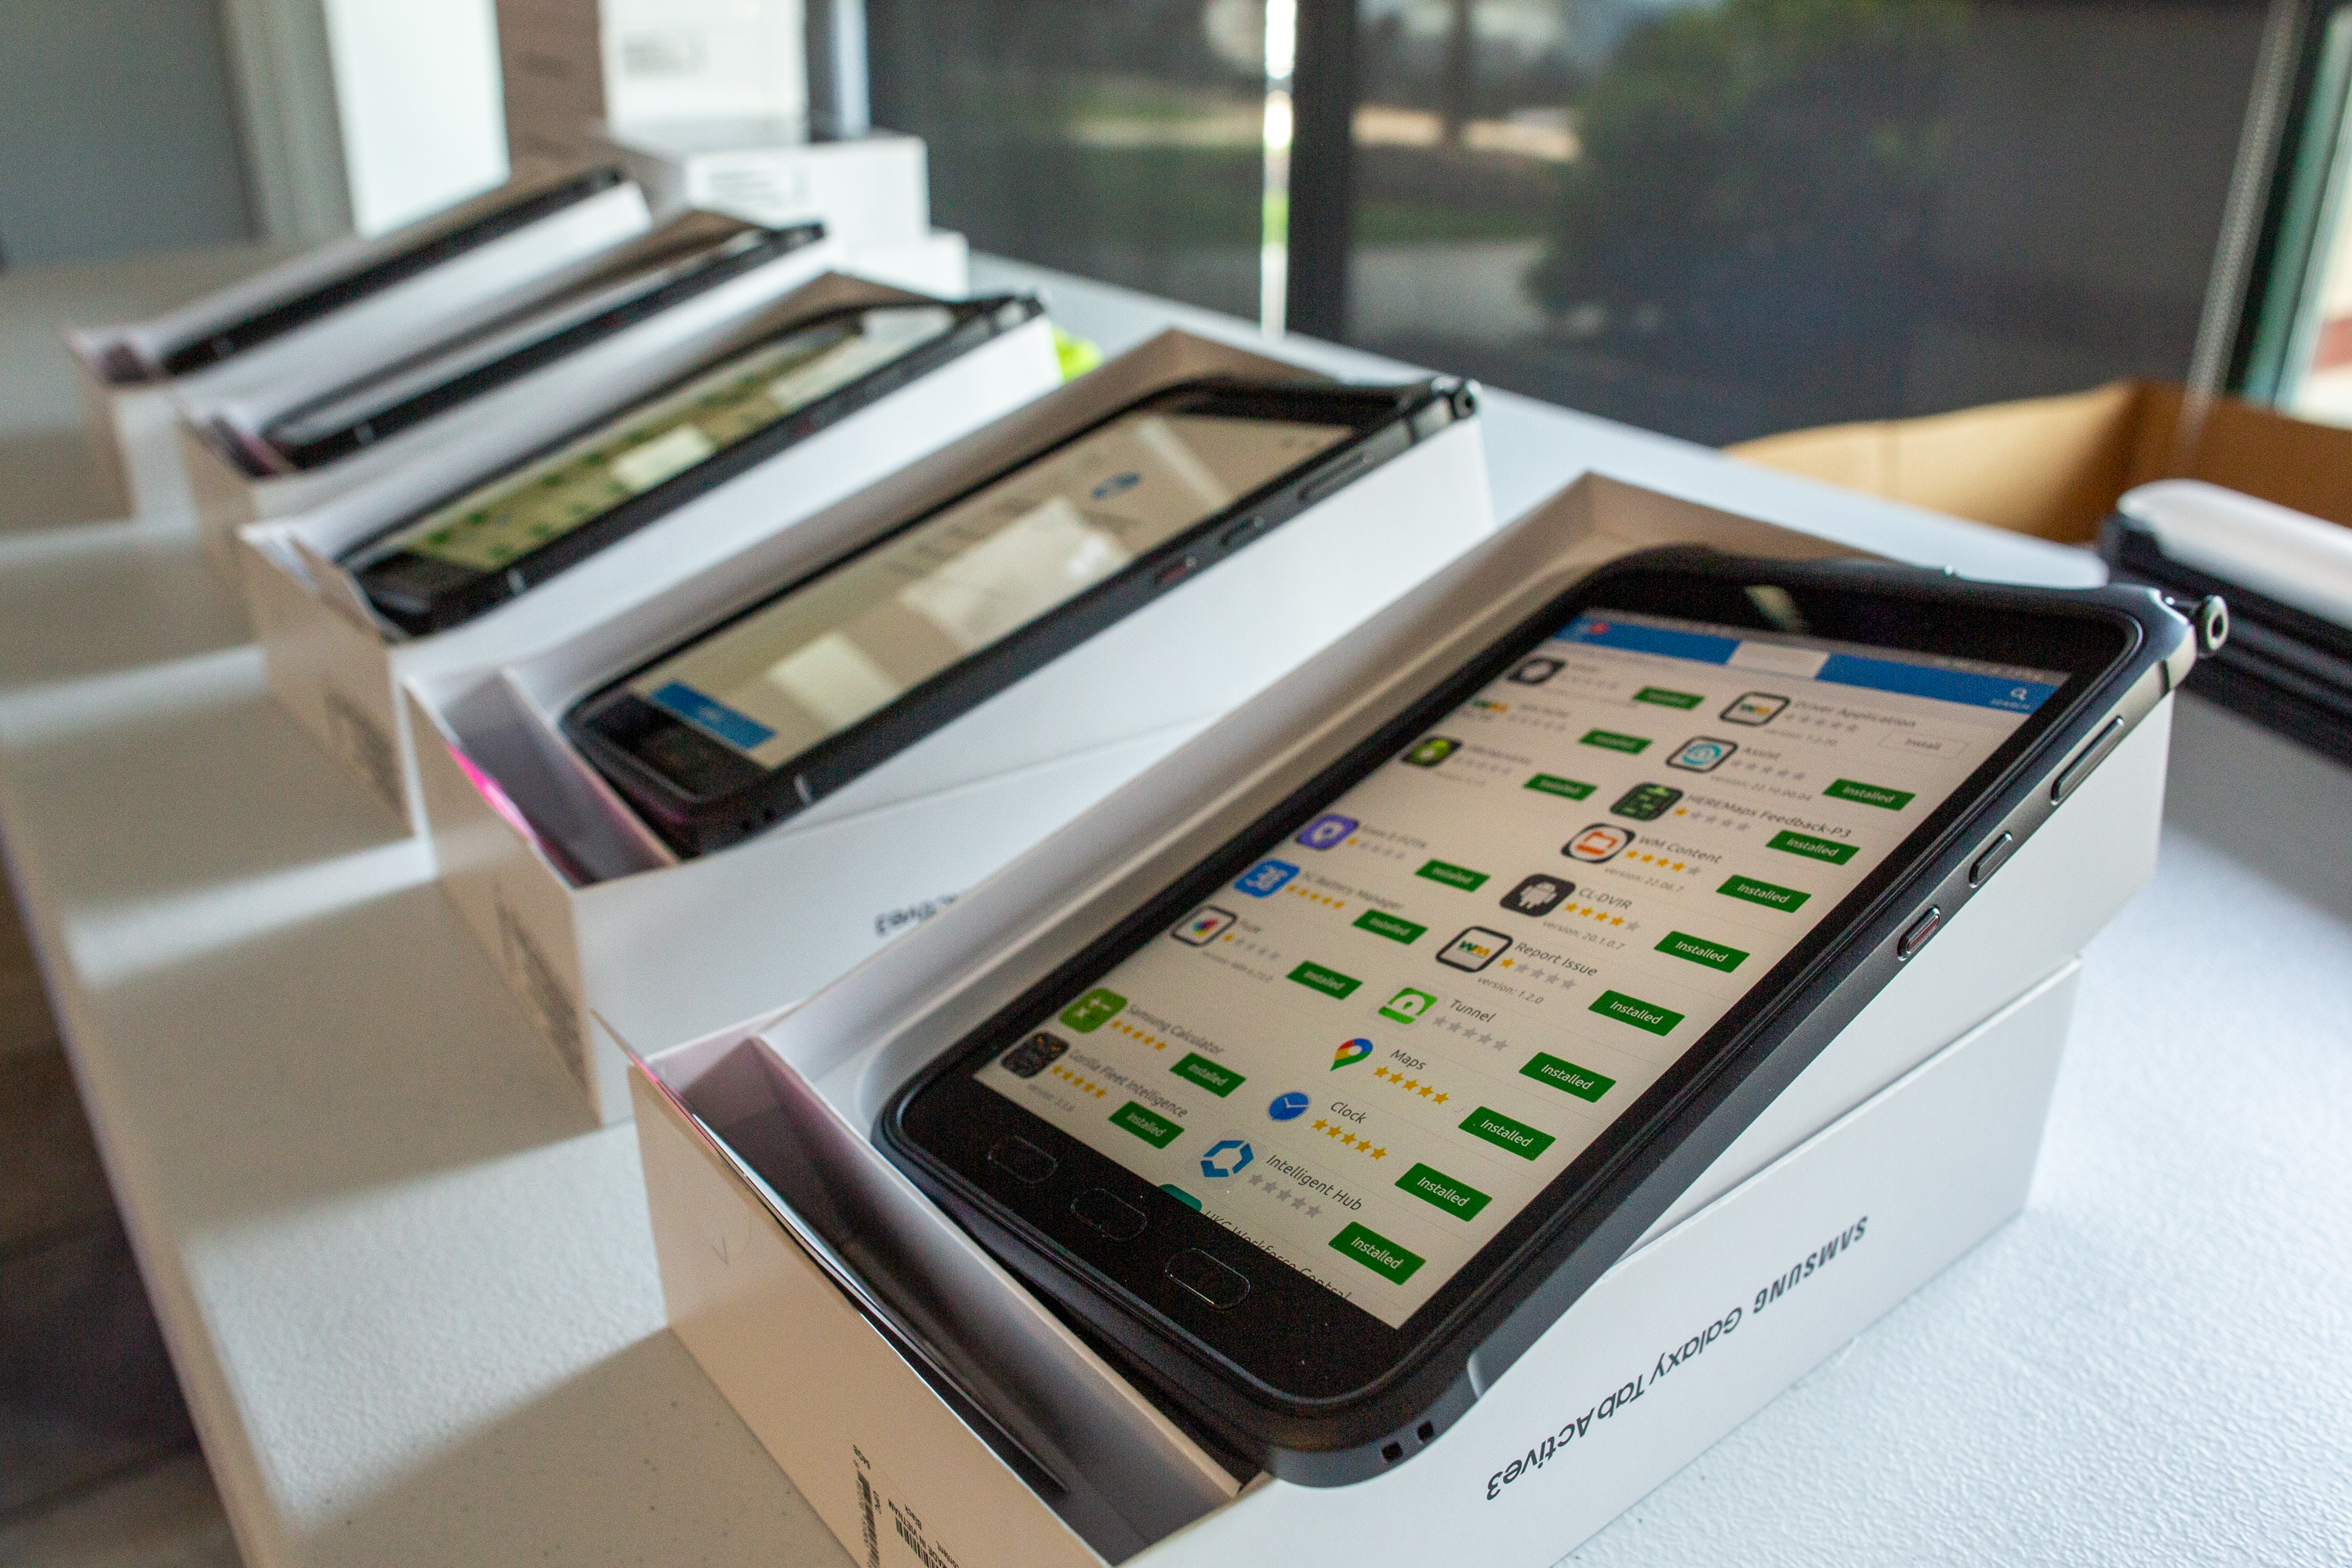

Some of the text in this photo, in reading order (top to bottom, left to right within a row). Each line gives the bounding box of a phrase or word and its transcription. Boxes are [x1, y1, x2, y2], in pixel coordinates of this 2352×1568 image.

[1838, 709, 1918, 728] Application
[1840, 786, 1896, 802] Installed
[1759, 811, 1853, 837] Feedback-P3
[1638, 837, 1723, 862] WM Content
[1784, 838, 1839, 855] Installed
[1578, 888, 1632, 909] CL-DVIR
[1736, 884, 1791, 902] Installed
[1543, 920, 1624, 949] version: 20.1.0.7
[1514, 943, 1599, 975] Report Issue
[1673, 940, 1728, 961] Installed
[1478, 977, 1543, 1004] version: 1.2.0
[1449, 1000, 1495, 1022] Tunnel
[1608, 1000, 1662, 1024] Installed
[1171, 1025, 1225, 1055] Calculator
[1389, 1050, 1427, 1071] Maps
[1540, 1064, 1594, 1089] Installed
[1123, 1080, 1189, 1120] Intelligence
[1330, 1102, 1367, 1123] Clock
[1125, 1112, 1166, 1137] Installed
[1479, 1119, 1533, 1147] Installed
[1265, 1155, 1364, 1210] Intelligent Hub
[1416, 1177, 1469, 1207] Installed
[1350, 1236, 1403, 1269] Installed
[1485, 1216, 1868, 1501] SAMSUNG Galaxy Tab Active3
